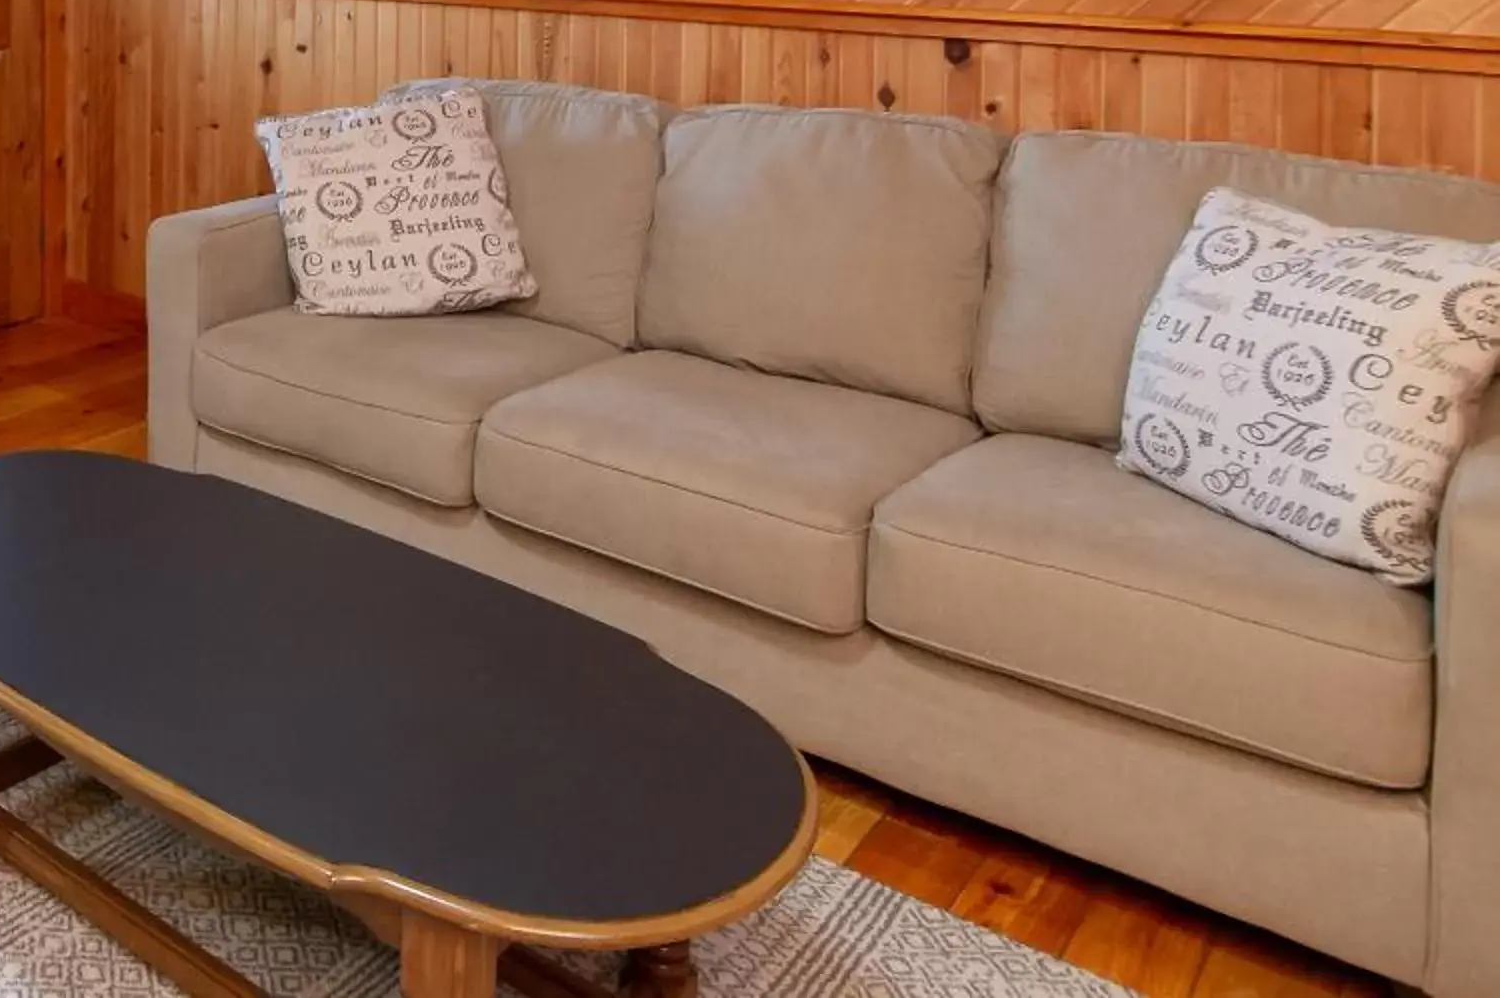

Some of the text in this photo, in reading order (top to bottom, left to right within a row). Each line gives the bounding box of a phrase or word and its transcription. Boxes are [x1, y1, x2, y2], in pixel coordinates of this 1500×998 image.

[389, 214, 485, 242] Darjeeling
[302, 249, 418, 280] Ceylan
[1252, 256, 1421, 312] Provence
[1243, 290, 1388, 347] Darjeeling
[1236, 411, 1332, 462] Thé
[1201, 460, 1341, 539] Provence
